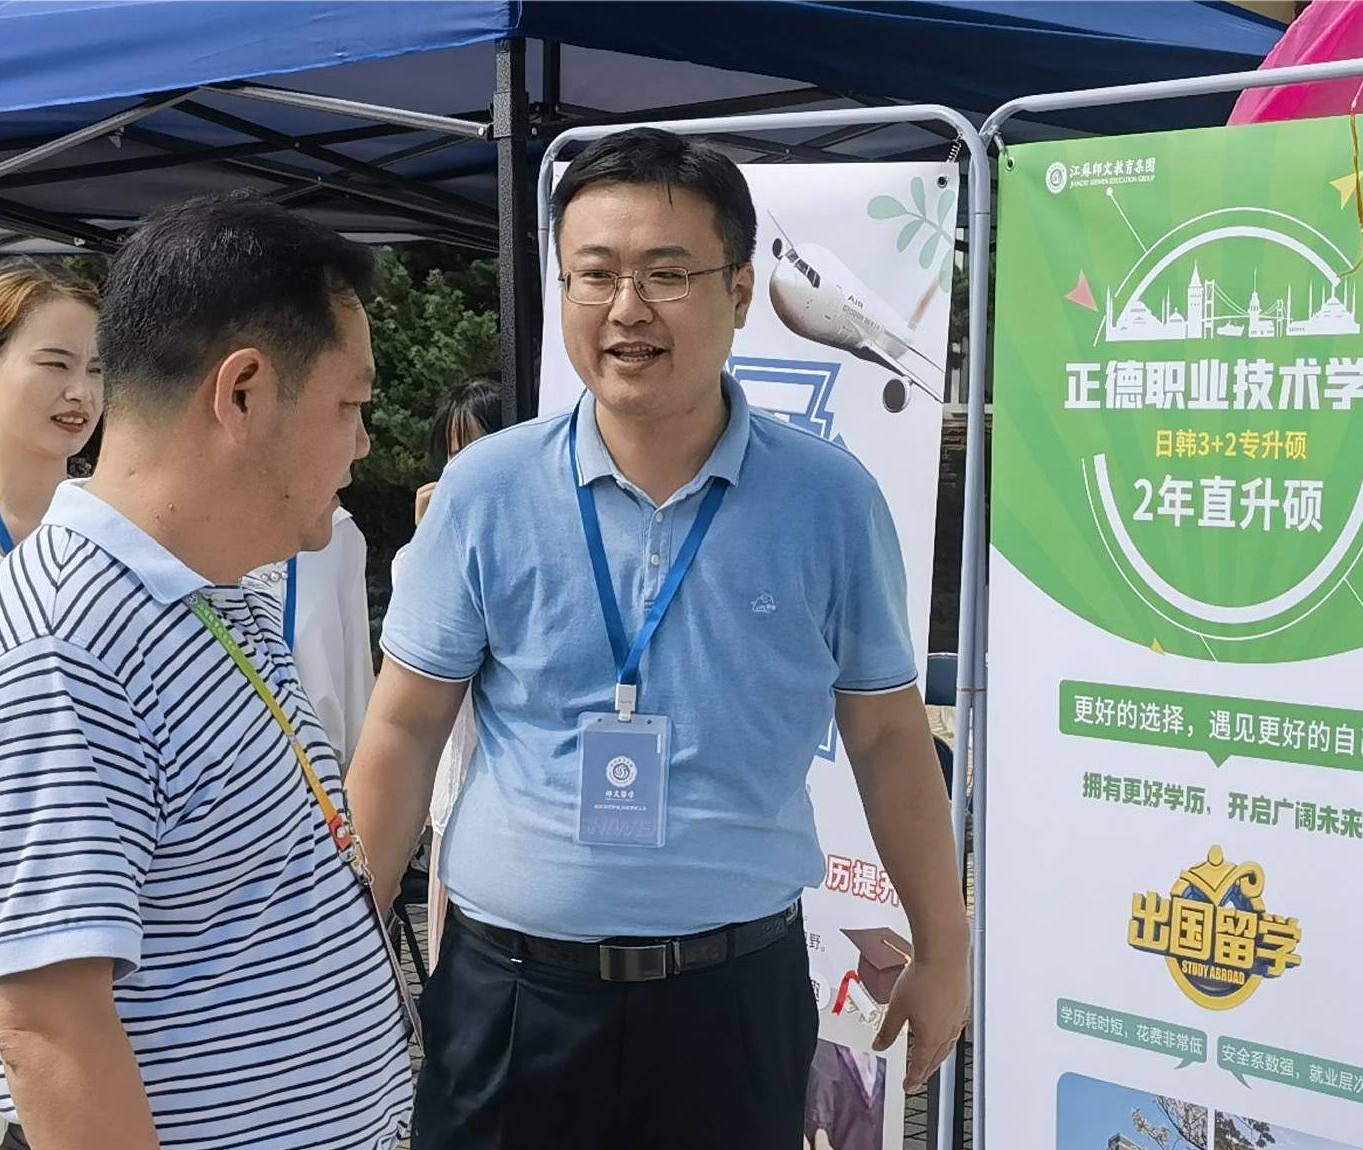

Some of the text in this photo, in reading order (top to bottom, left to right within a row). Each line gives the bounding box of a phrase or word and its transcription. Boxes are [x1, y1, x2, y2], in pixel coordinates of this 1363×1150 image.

[1156, 429, 1308, 461] 日韩3+2专升硕
[1133, 474, 1324, 533] 2年直升硕
[1083, 772, 1363, 839] 拥有更好学历，开启广阔未来
[1127, 890, 1302, 979] 出国留学
[1181, 959, 1245, 985] STUDY ABROAD
[1060, 1007, 1203, 1055] 学历耗时短，花费非常低
